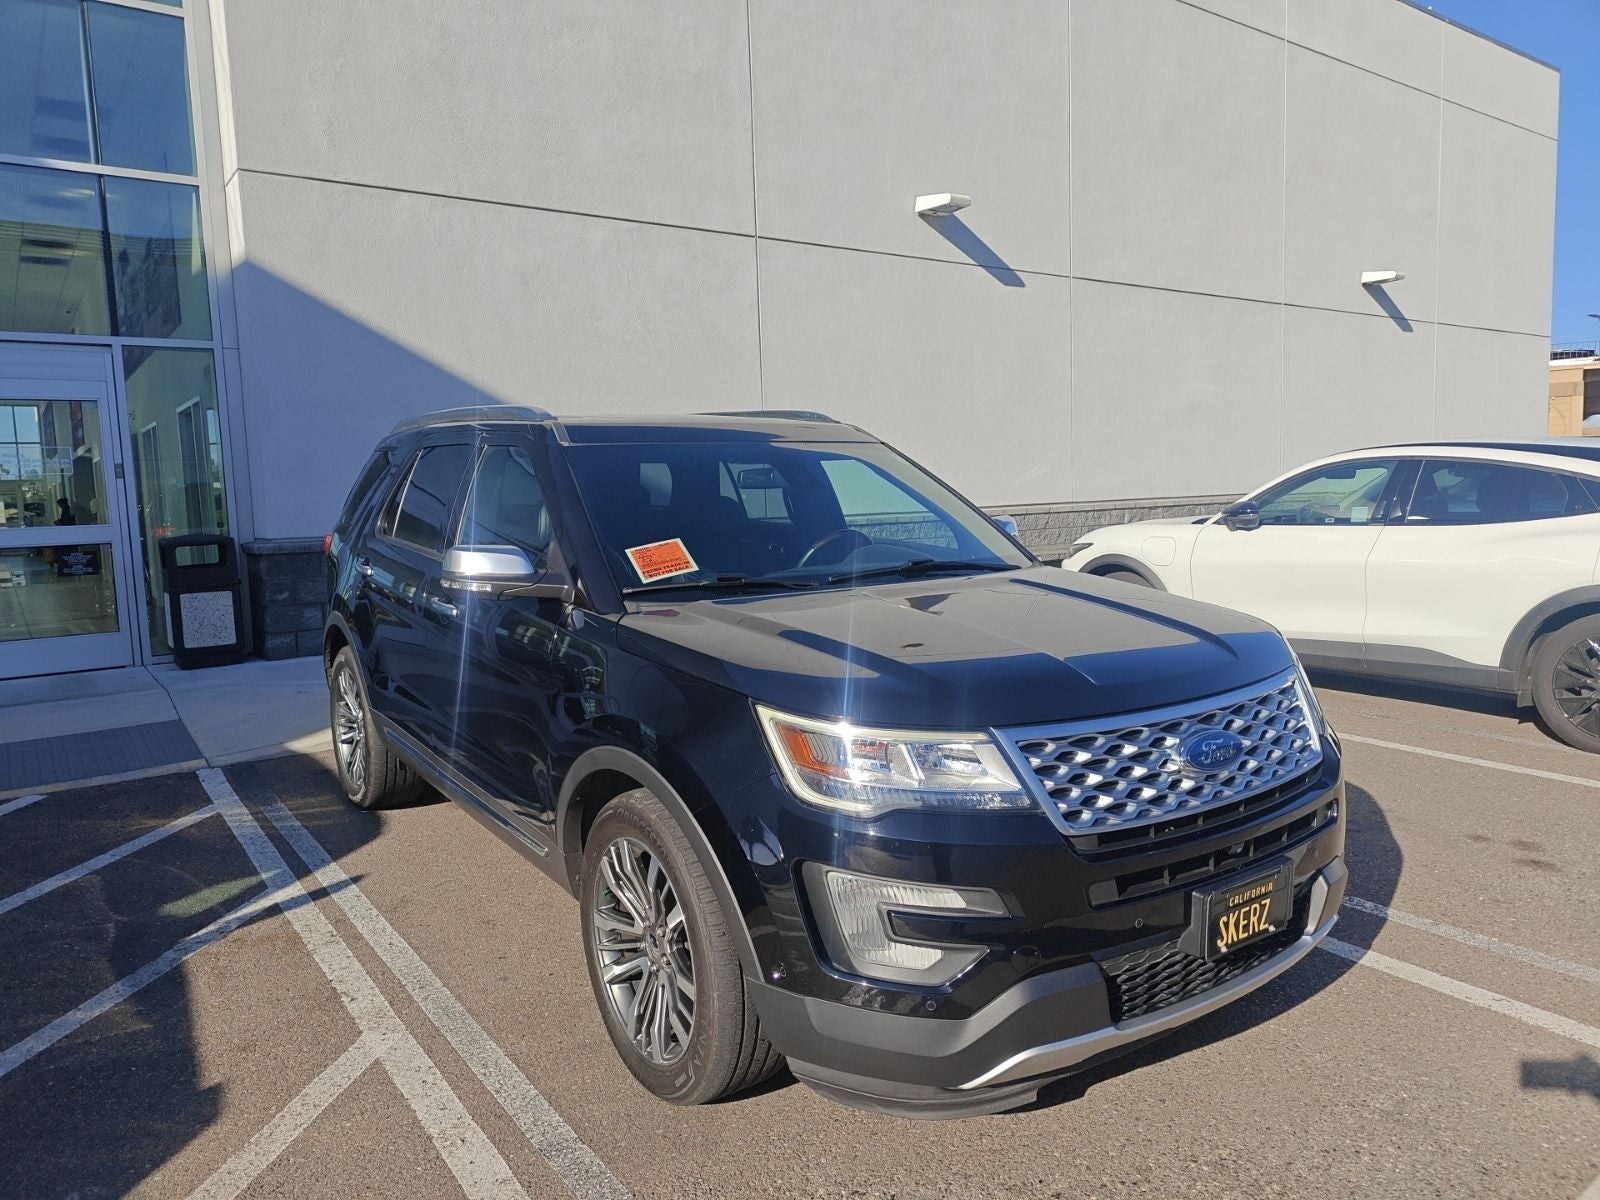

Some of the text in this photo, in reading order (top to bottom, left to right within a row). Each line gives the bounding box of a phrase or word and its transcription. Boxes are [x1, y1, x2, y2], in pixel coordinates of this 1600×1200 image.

[1202, 737, 1237, 764] Ford
[1229, 881, 1273, 906] CALIFORNIA
[1217, 897, 1270, 948] SKERZ
